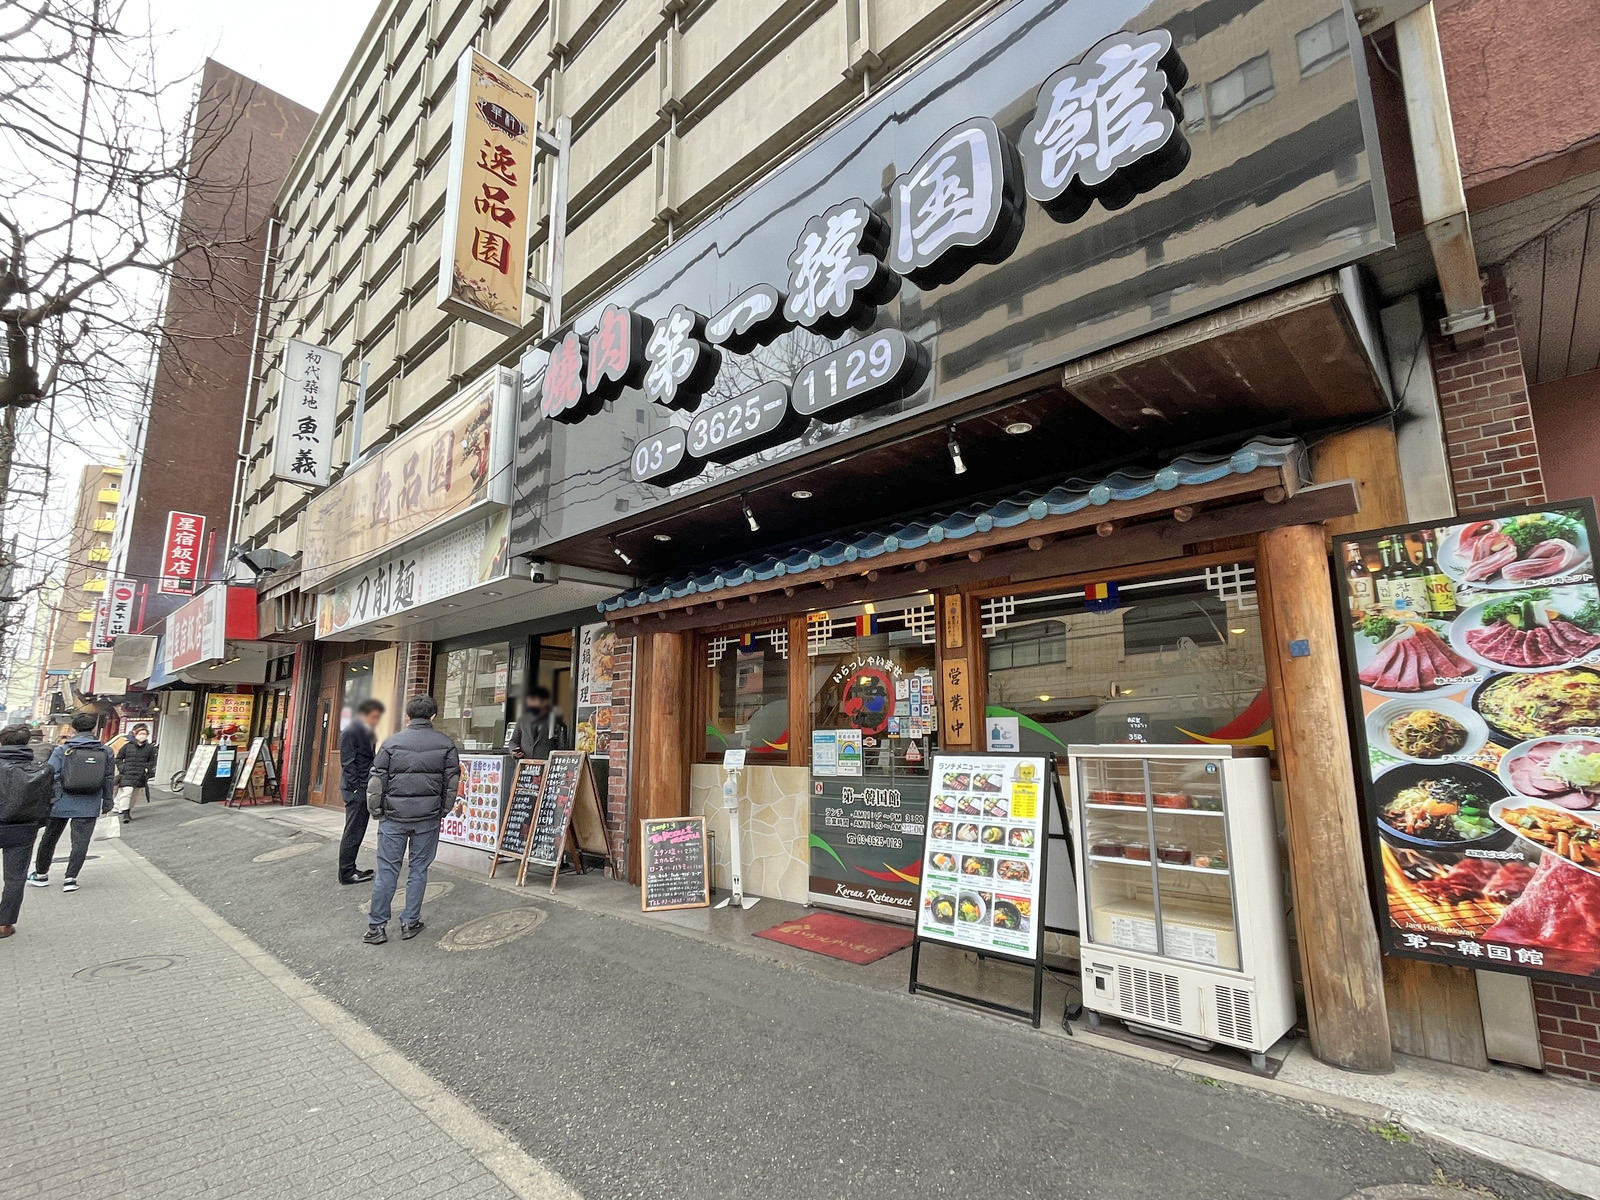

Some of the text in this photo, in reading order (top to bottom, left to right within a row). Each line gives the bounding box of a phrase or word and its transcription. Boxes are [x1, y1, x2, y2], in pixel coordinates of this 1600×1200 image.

[472, 139, 518, 275] 逸品園
[645, 41, 1172, 404] 第一韓国館
[291, 349, 322, 477] 初代築地 魚義
[168, 516, 197, 575] 星宿飯店
[580, 630, 591, 703] 石鍋料理
[833, 656, 903, 683] いらっしゃいませ
[1434, 676, 1483, 686] 特上カルビ
[948, 667, 964, 738] 営業中
[938, 762, 980, 771] ランチメニュー
[842, 786, 902, 807] 第一韓国館
[825, 807, 843, 817] ランチ
[825, 817, 850, 828] 営業時間
[835, 883, 913, 907] Korean Restaurant
[1402, 933, 1544, 966] 第一韓国館
